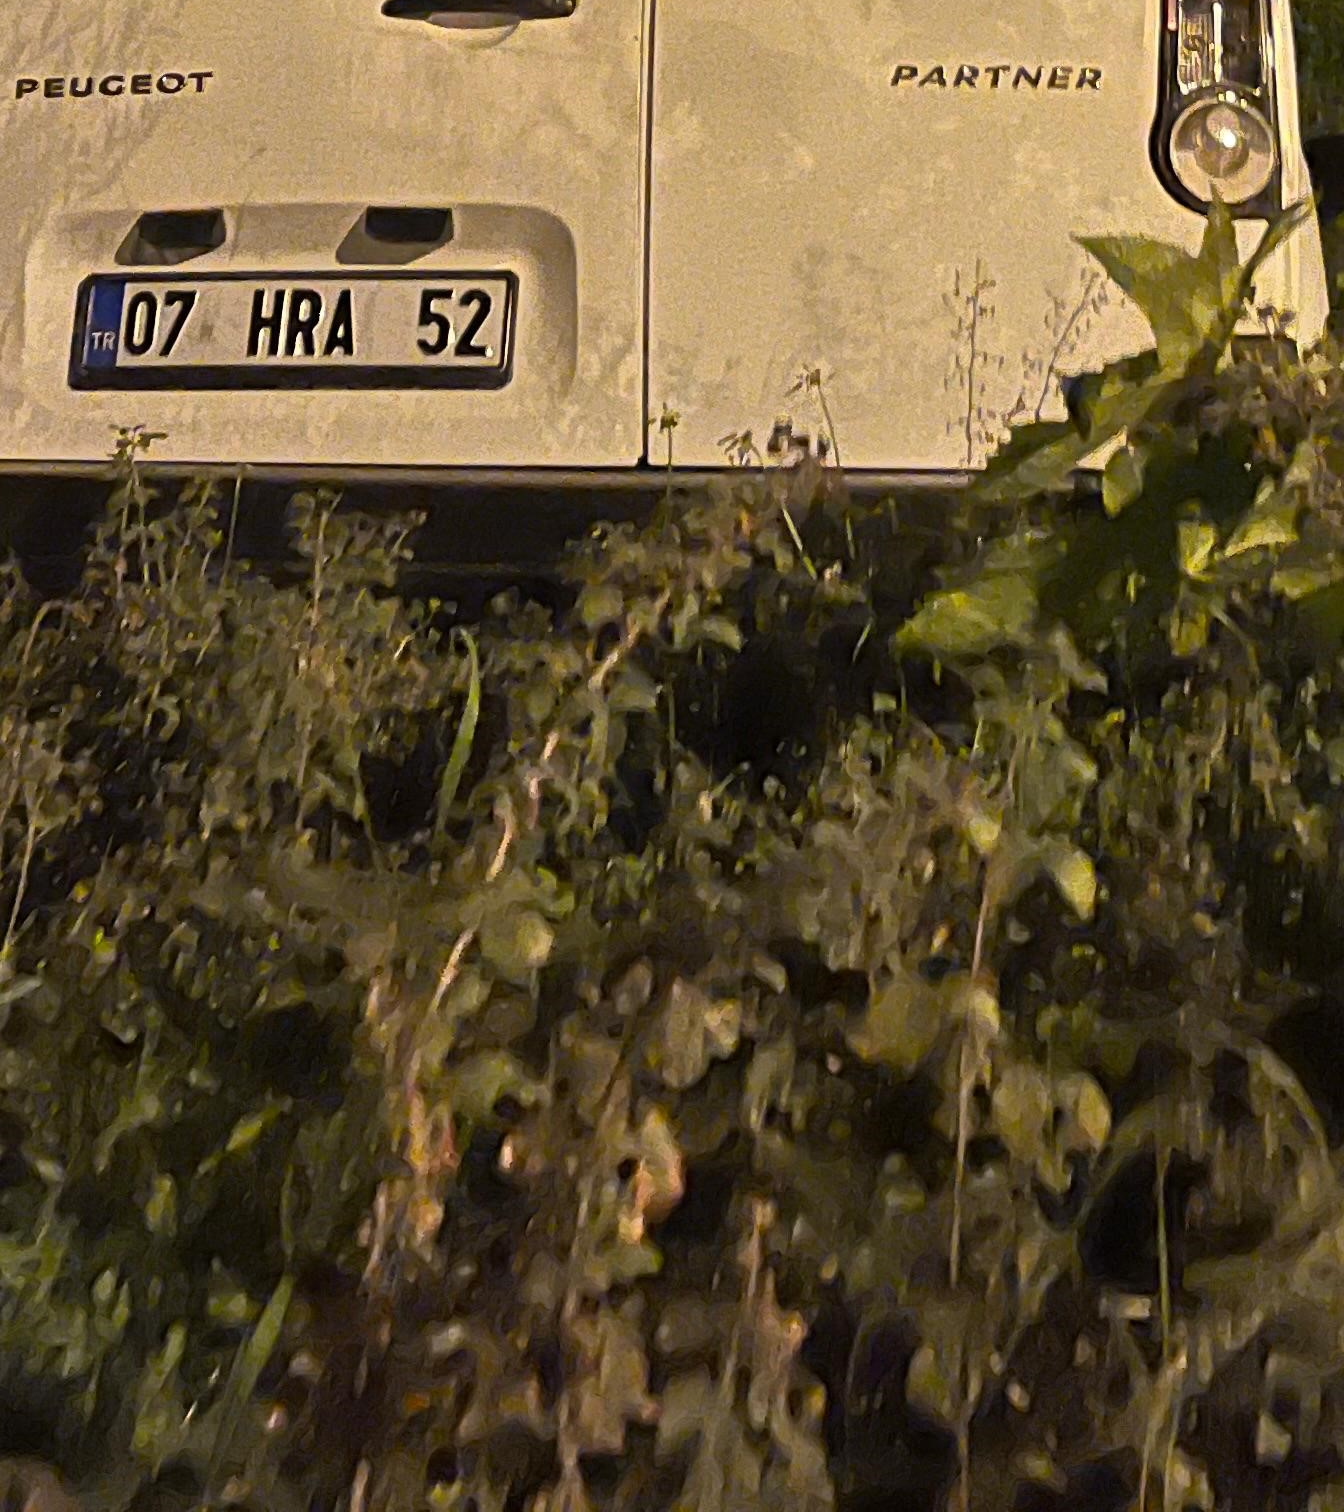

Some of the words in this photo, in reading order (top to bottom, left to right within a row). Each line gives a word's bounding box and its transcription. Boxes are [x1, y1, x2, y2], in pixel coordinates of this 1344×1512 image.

[15, 71, 213, 99] PEUGEOT
[890, 64, 1102, 90] PARTNER
[91, 330, 116, 351] TR
[123, 289, 197, 357] 07
[246, 289, 355, 357] HRA
[416, 289, 493, 357] 52
